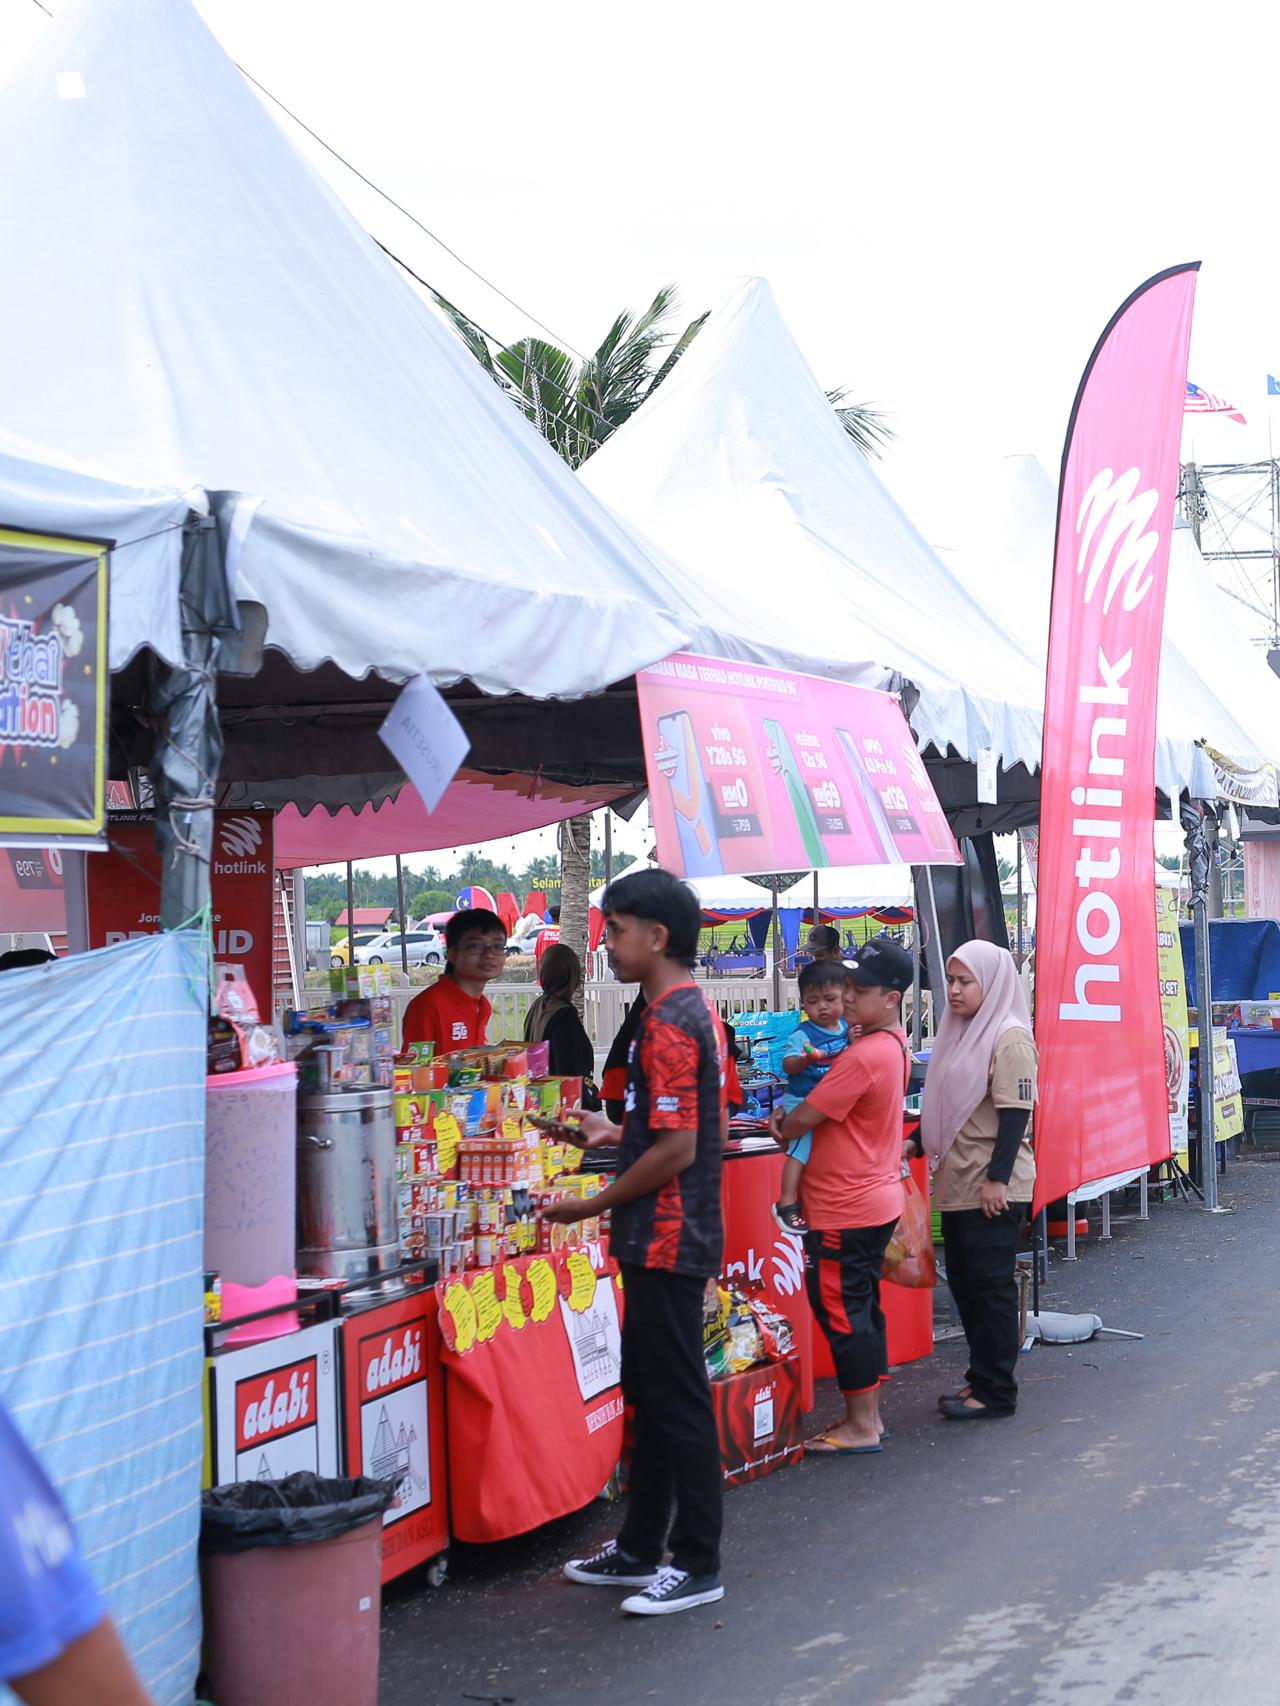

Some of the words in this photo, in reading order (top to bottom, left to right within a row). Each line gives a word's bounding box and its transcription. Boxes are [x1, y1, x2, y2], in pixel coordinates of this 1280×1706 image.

[711, 721, 731, 741] vivo
[732, 747, 747, 766] 5G
[815, 752, 828, 768] 5G
[1059, 646, 1133, 1022] hotlink
[214, 861, 267, 874] hotlink
[451, 1026, 469, 1041] 5G
[366, 1329, 422, 1393] adabi
[243, 1370, 310, 1441] adabi
